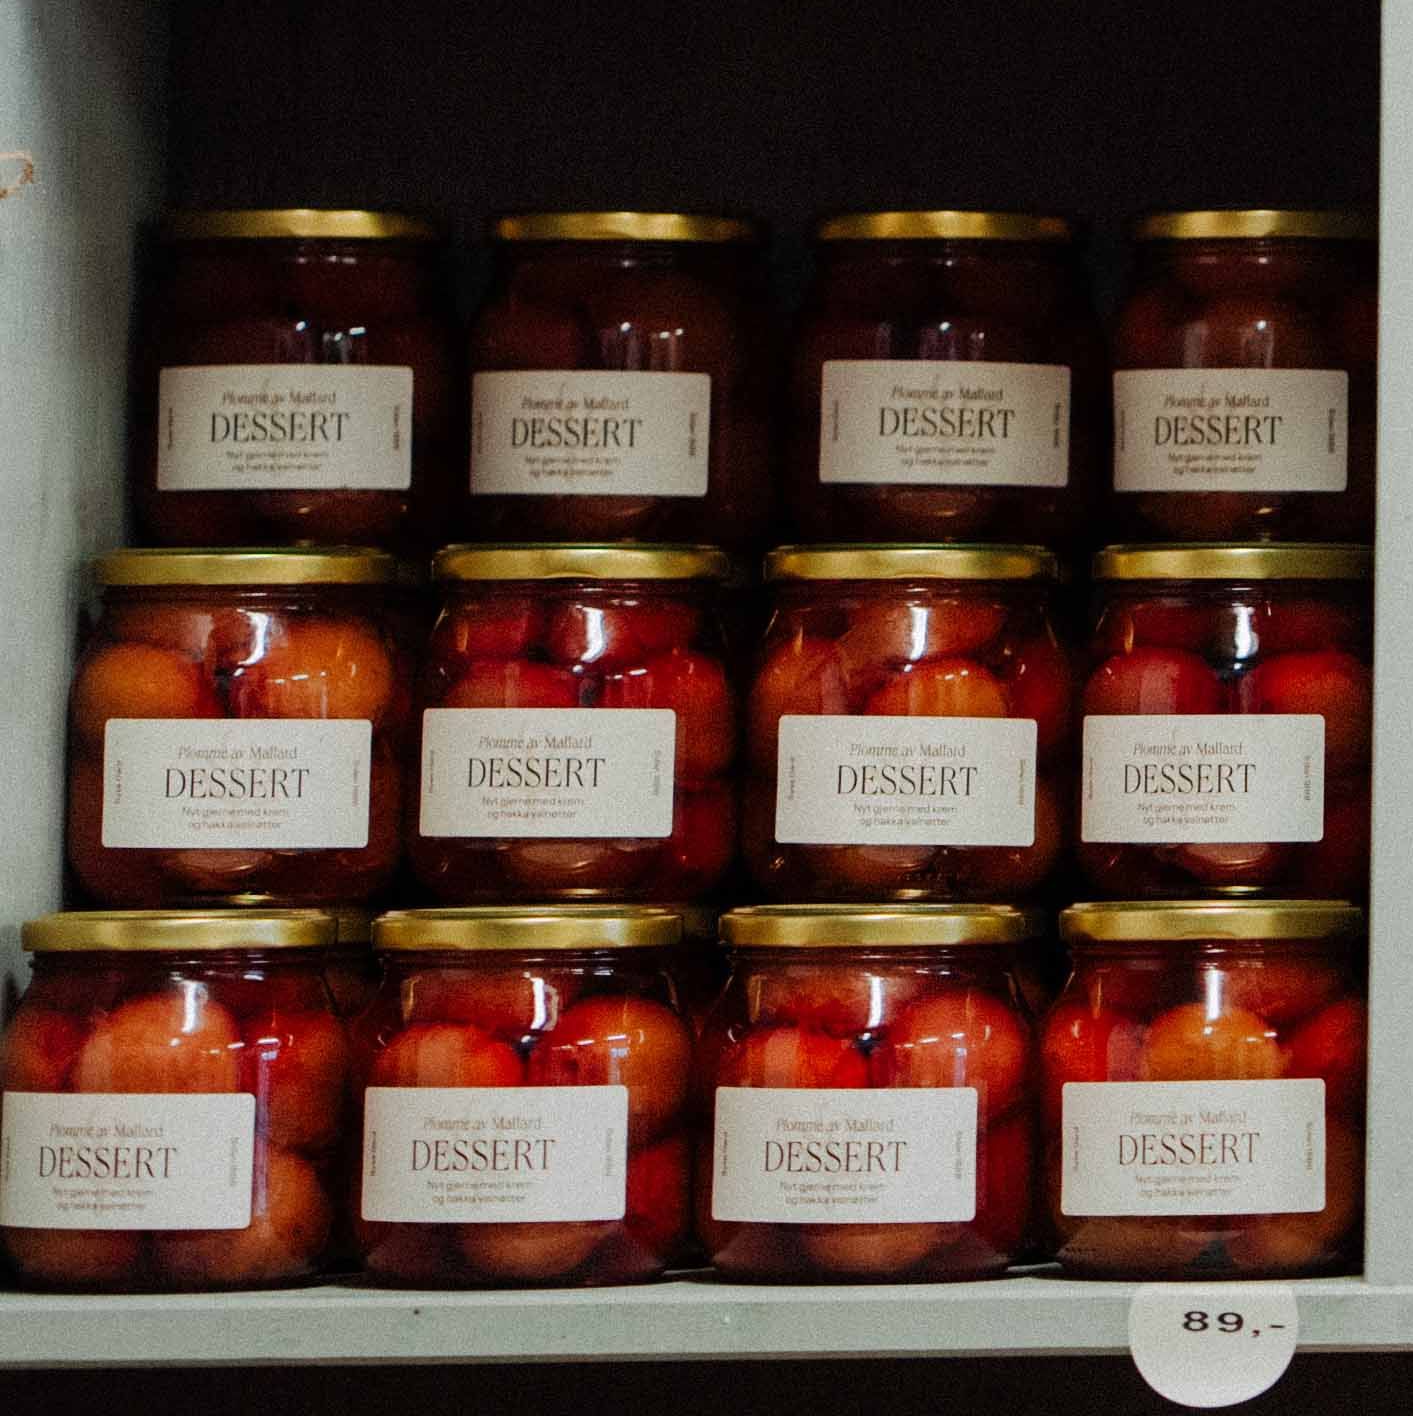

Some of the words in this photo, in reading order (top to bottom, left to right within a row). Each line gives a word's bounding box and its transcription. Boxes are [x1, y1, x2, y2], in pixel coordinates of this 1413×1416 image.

[211, 412, 350, 443] DESSERT
[511, 417, 643, 448] DESSERT
[879, 407, 1016, 439] DESSERT
[1154, 415, 1283, 446] DESSERT
[165, 768, 310, 798] DESSERT
[467, 758, 606, 788] DESSERT
[837, 765, 978, 796] DESSERT
[1124, 763, 1257, 794] DESSERT
[39, 1145, 177, 1179] DESSERT
[411, 1139, 556, 1171] DESSERT
[764, 1141, 907, 1173] DESSERT
[1119, 1133, 1260, 1166] DESSERT
[1182, 1310, 1285, 1338] 89,-
